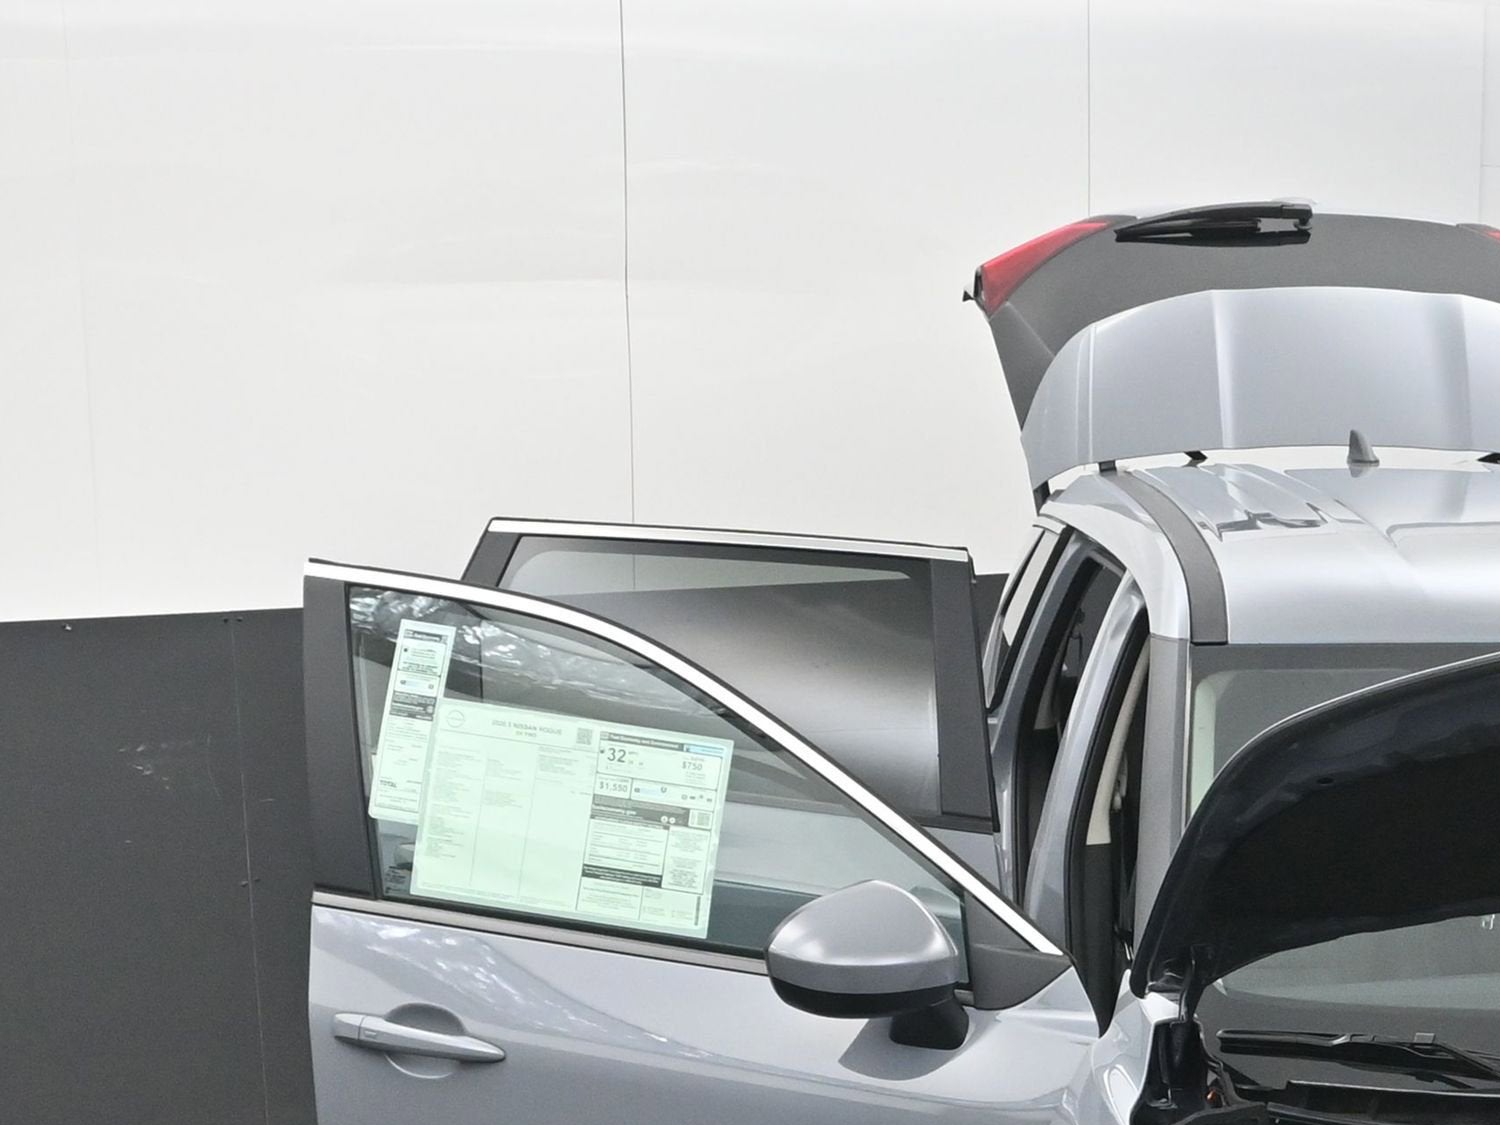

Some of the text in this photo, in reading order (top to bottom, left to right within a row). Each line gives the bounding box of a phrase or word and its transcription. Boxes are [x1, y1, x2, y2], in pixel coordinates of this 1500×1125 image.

[607, 747, 626, 763] 32
[682, 761, 703, 771] $750
[599, 781, 628, 793] $1,550
